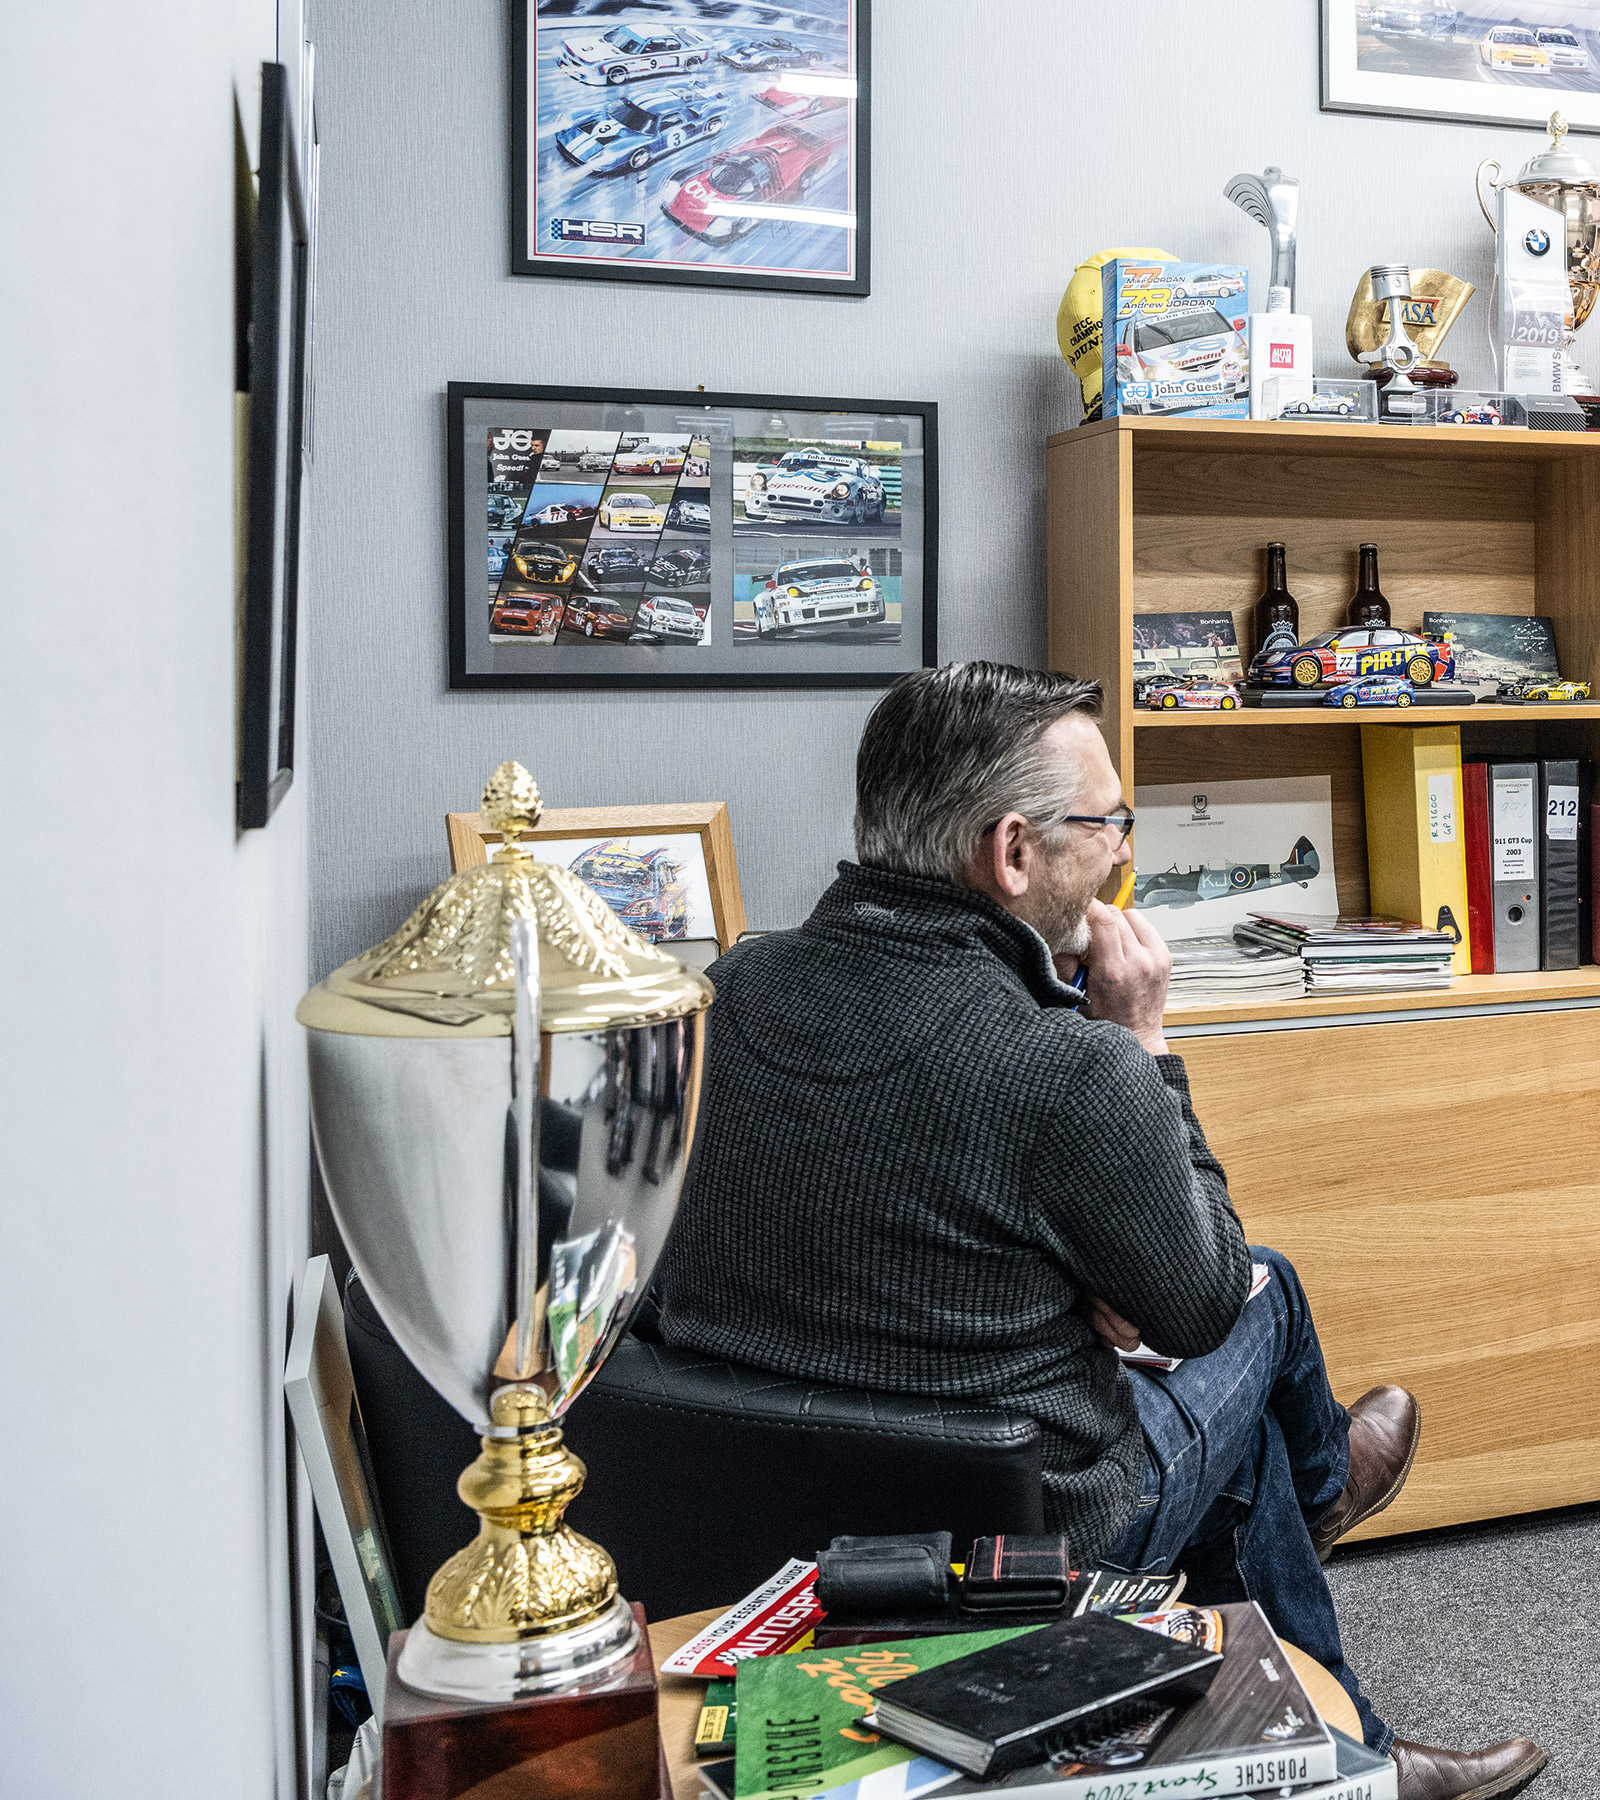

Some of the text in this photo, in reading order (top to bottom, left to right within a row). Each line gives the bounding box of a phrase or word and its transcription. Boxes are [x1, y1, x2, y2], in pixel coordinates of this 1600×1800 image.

[650, 59, 657, 69] 9
[673, 133, 681, 147] 3
[562, 221, 643, 239] HSR
[1123, 267, 1163, 288] 77
[1147, 276, 1186, 284] JORDAN
[1119, 288, 1172, 315] 78
[1122, 299, 1215, 310] Andrew JORDAN
[1156, 307, 1212, 322] John Guest
[1070, 318, 1103, 347] CHAMPIO
[1072, 316, 1093, 333] BTCC
[1516, 326, 1559, 345] 2019
[1172, 351, 1222, 367] Speedfit
[1272, 348, 1292, 356] AUTO
[1553, 361, 1562, 393] BMW
[1155, 384, 1183, 397] John
[1186, 381, 1223, 393] Guest
[493, 453, 510, 461] John
[828, 456, 853, 464] Guest
[550, 512, 560, 521] 77
[801, 592, 868, 604] PARAGON
[1428, 617, 1457, 625] Bonhams
[1340, 657, 1353, 668] 77
[1361, 643, 1431, 675] PIRTEK
[1370, 686, 1399, 695] PIRTEK
[1548, 799, 1577, 816] 212
[1521, 837, 1533, 845] Cup
[1201, 873, 1228, 889] KJ
[674, 1563, 808, 1667] F1 2019 YOUR ESSENTIAL GUIDE
[736, 1582, 820, 1659] AUTOSP
[765, 1713, 824, 1800] ORSCHE
[1236, 1756, 1307, 1787] PORSCHE
[1142, 1766, 1218, 1795] Sport
